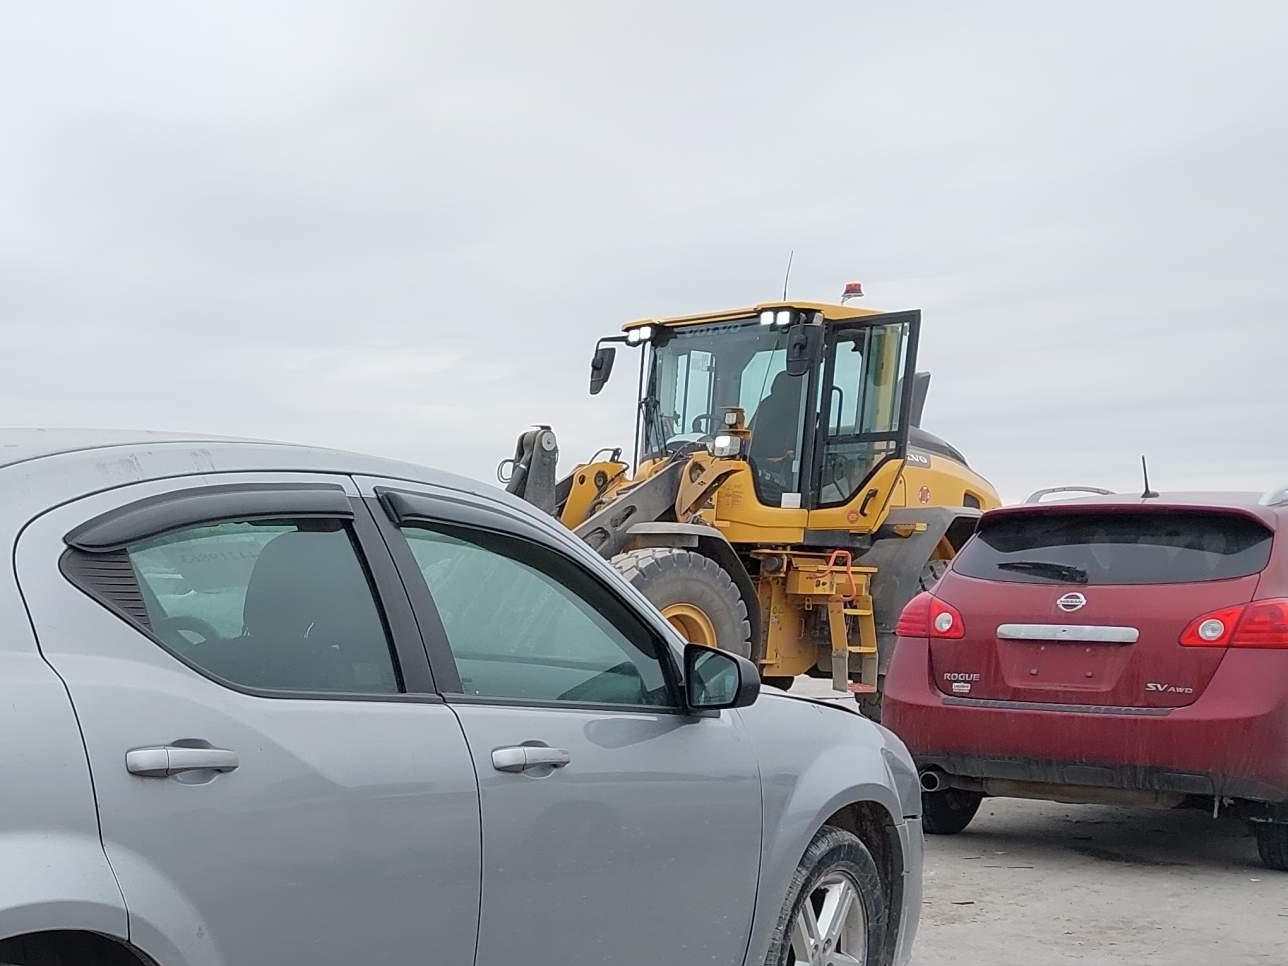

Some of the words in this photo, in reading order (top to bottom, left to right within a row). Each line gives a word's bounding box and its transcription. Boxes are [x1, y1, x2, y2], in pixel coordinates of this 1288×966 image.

[943, 672, 980, 681] ROGUE
[1145, 683, 1169, 691] SV
[1167, 686, 1193, 694] AWD
